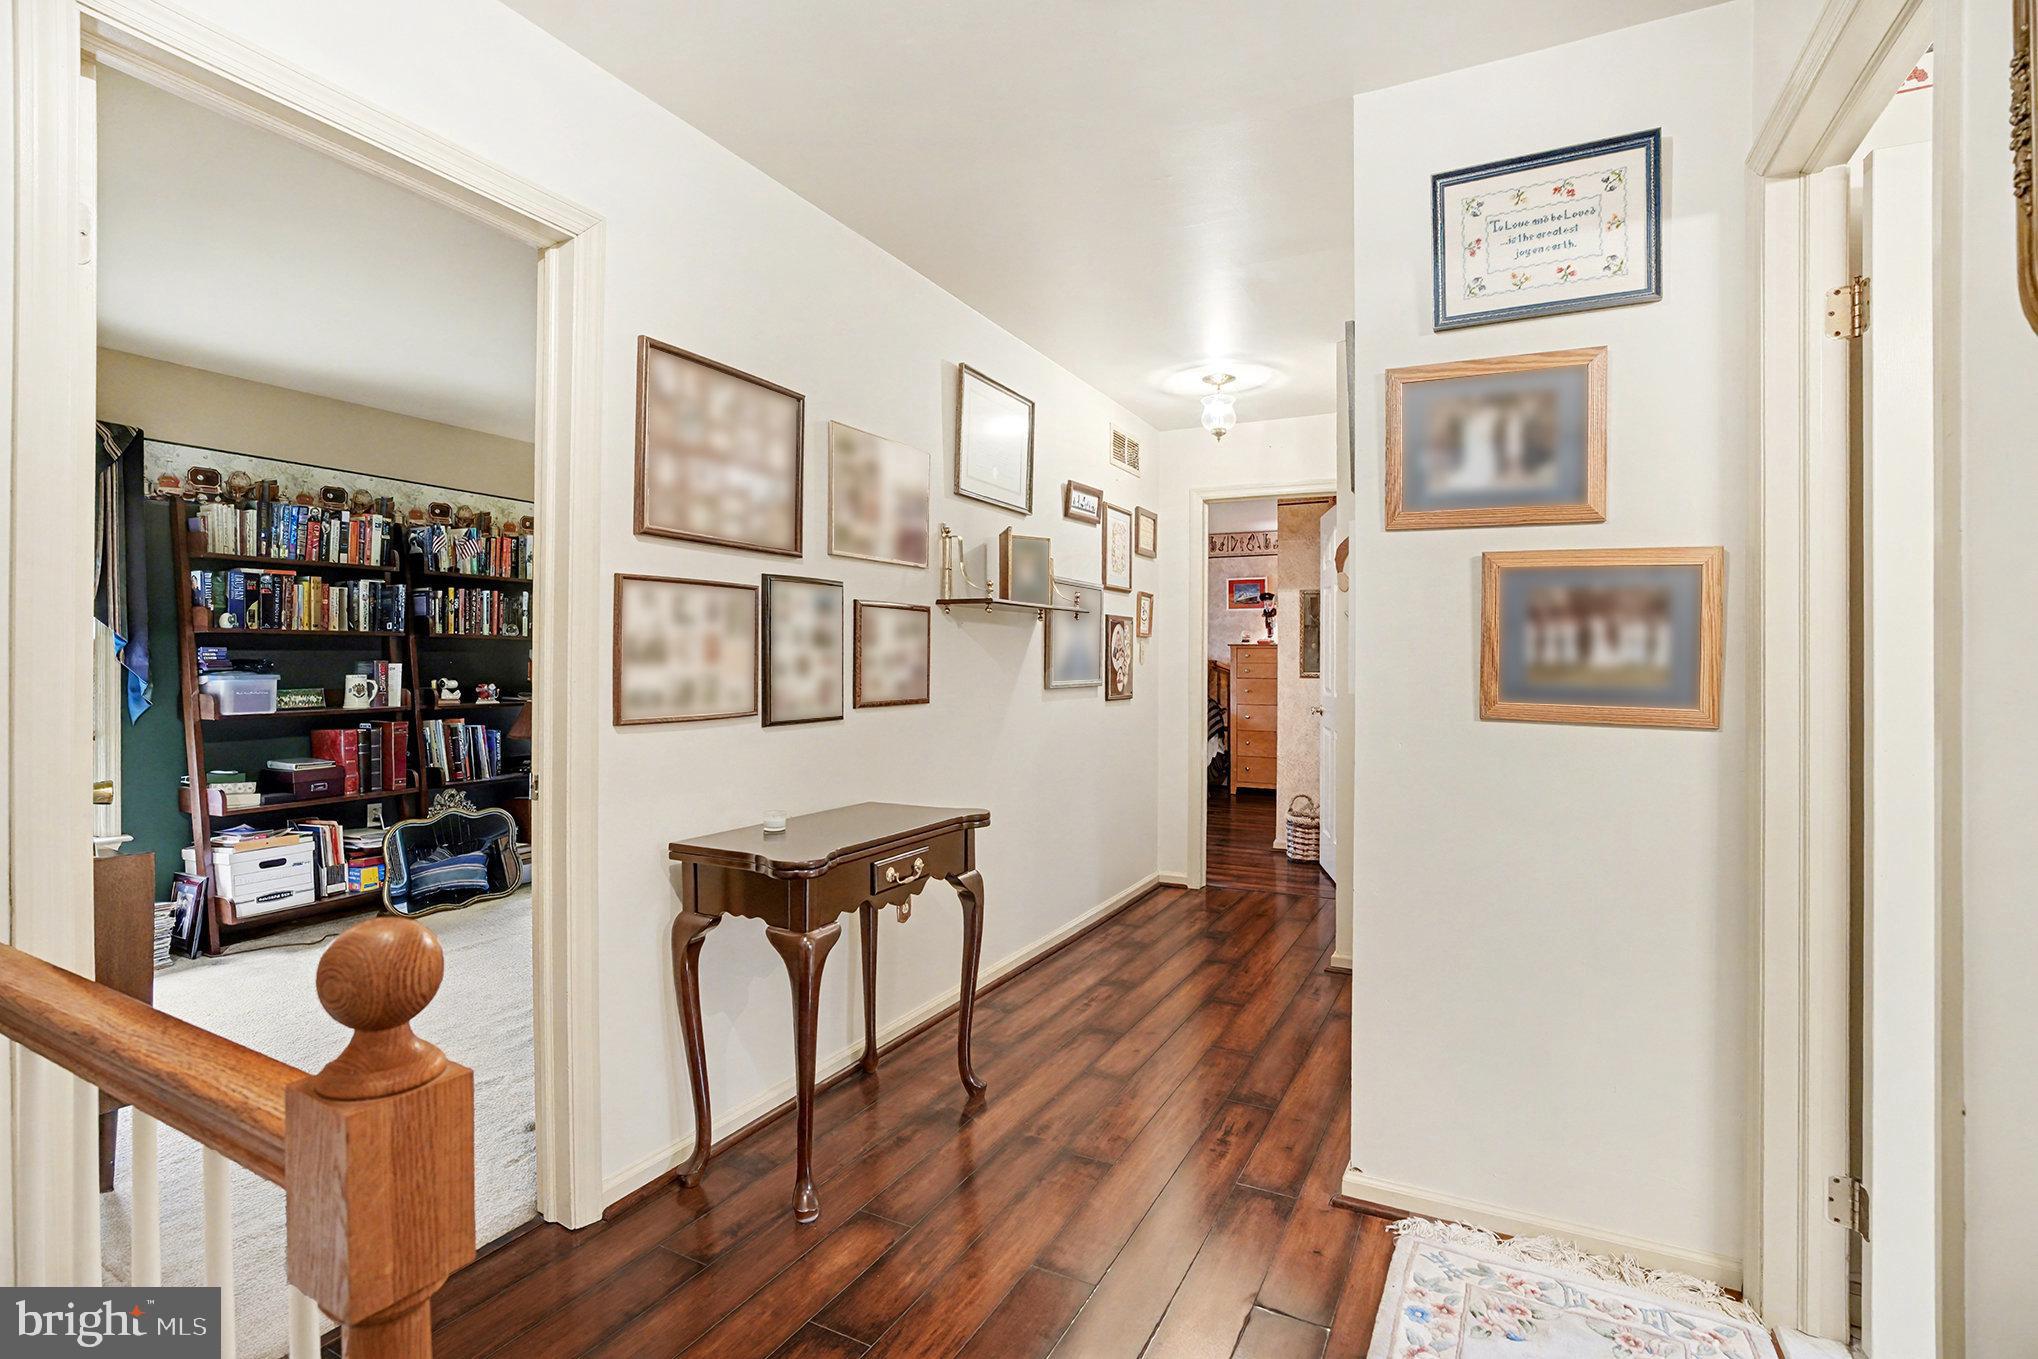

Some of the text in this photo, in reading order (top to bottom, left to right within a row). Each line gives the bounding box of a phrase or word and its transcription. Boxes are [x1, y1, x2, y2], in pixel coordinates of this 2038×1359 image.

[1505, 220, 1530, 231] Love
[1532, 215, 1548, 225] and
[1551, 213, 1562, 222] be
[1564, 207, 1596, 220] Loved
[1518, 233, 1534, 243] the
[1514, 248, 1531, 260] joy
